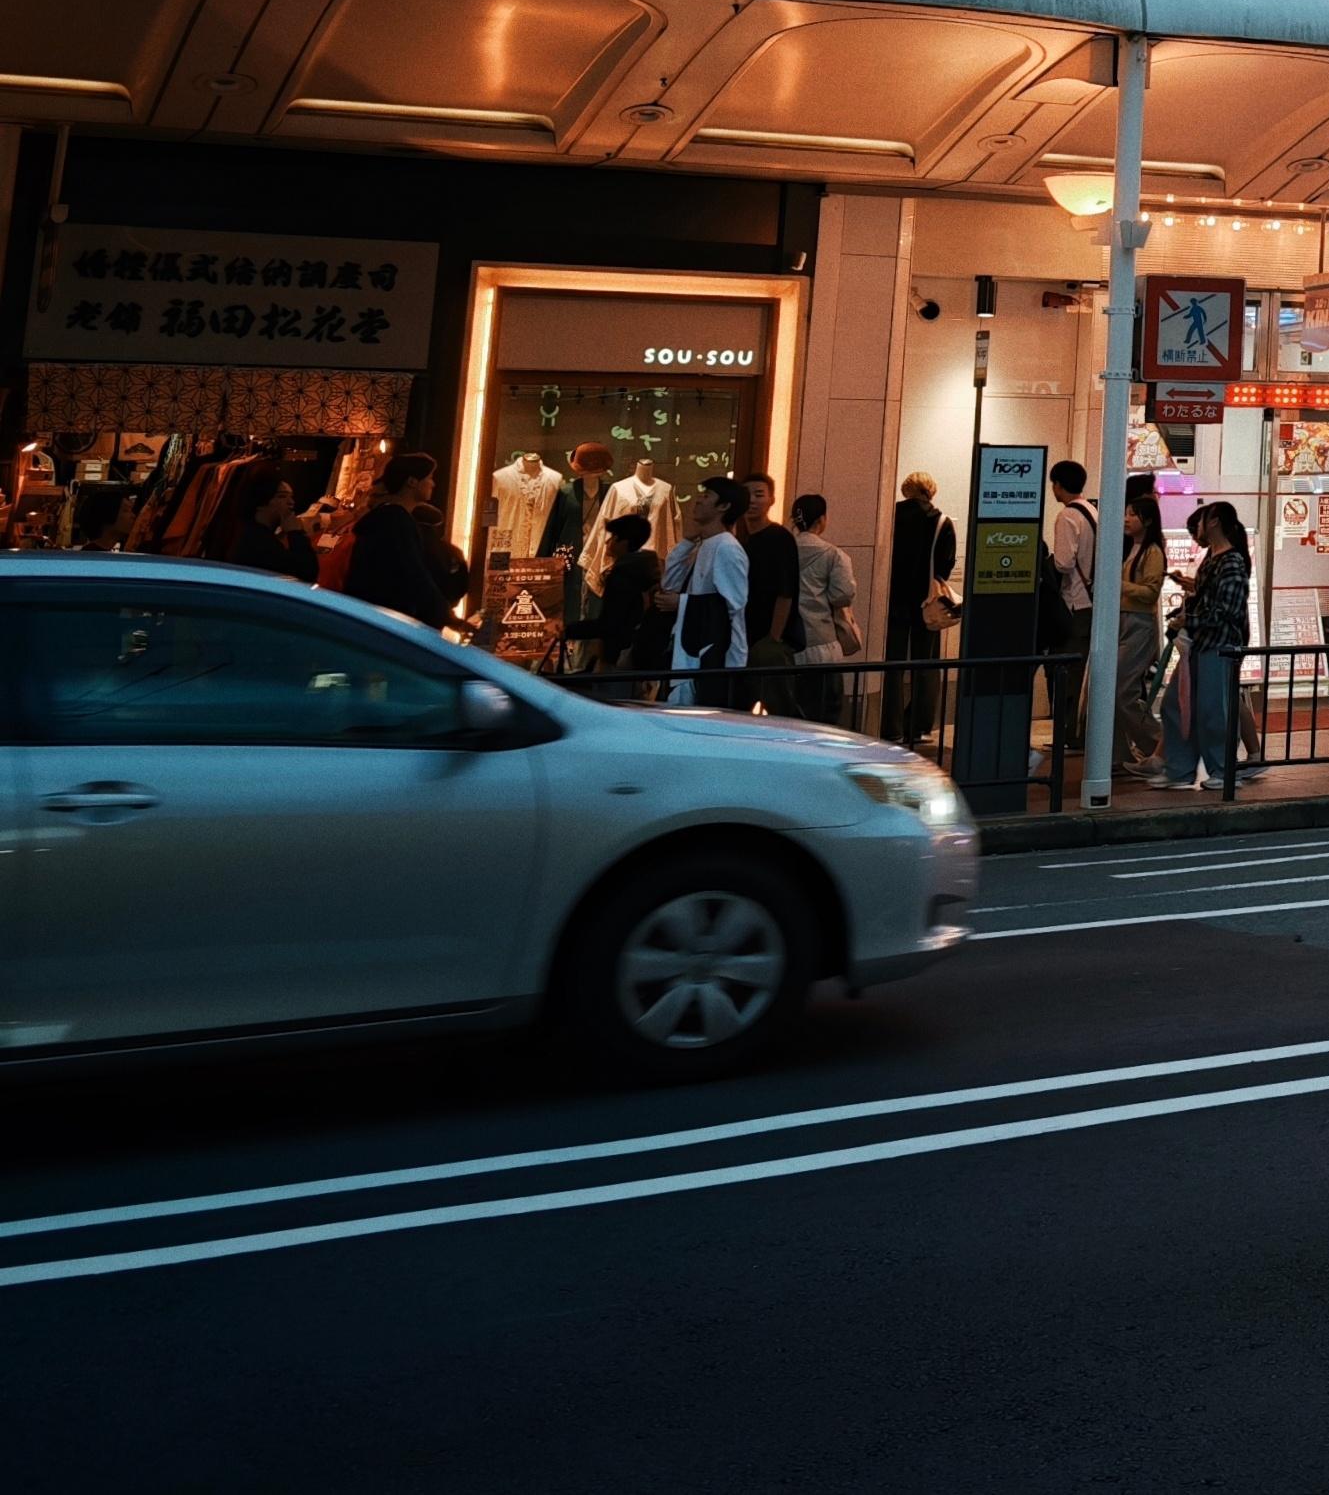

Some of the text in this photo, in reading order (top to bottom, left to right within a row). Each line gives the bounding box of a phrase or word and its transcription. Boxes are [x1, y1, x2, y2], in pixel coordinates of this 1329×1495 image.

[1162, 349, 1209, 363] 横断禁止
[1162, 404, 1218, 418] わたるな
[992, 458, 1032, 478] hoop
